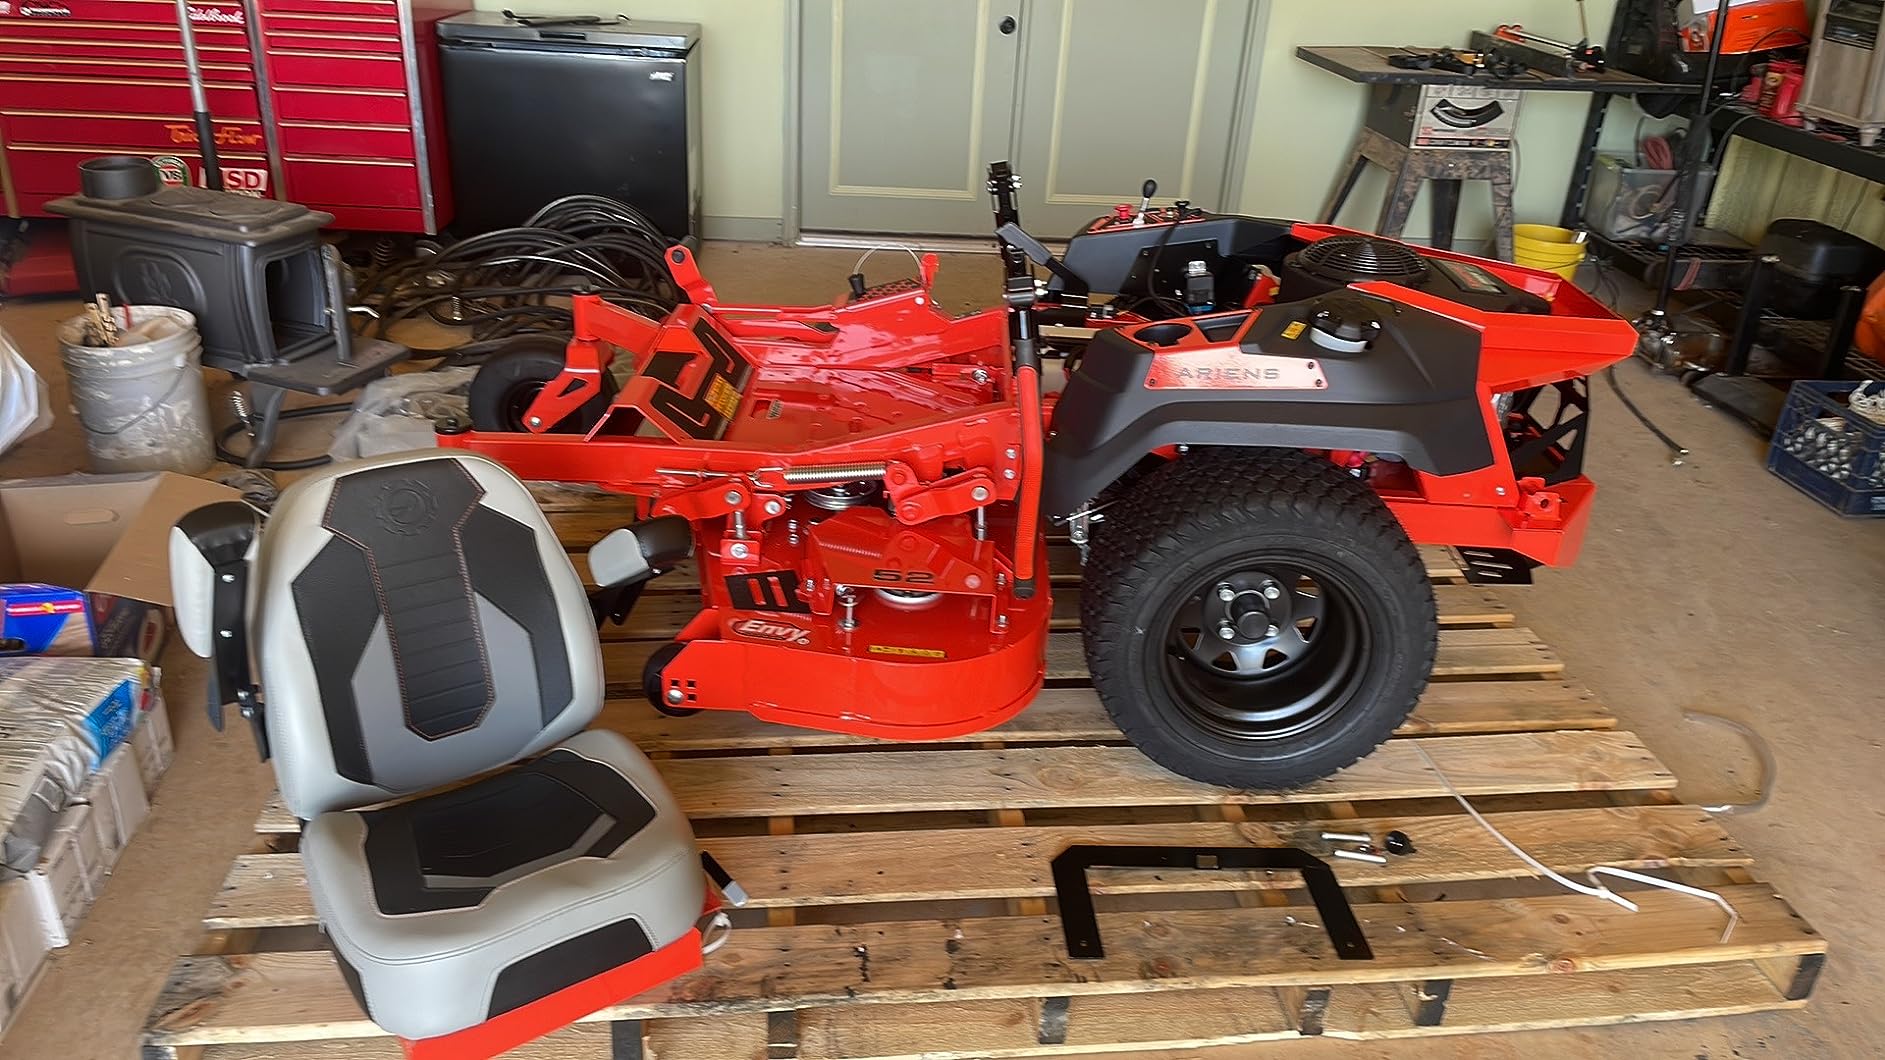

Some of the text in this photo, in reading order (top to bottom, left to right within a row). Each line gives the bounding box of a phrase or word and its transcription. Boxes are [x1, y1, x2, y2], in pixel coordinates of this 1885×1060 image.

[218, 170, 260, 188] SD
[1178, 367, 1281, 380] ARIENS
[874, 569, 935, 584] 52
[739, 619, 811, 642] Envy
